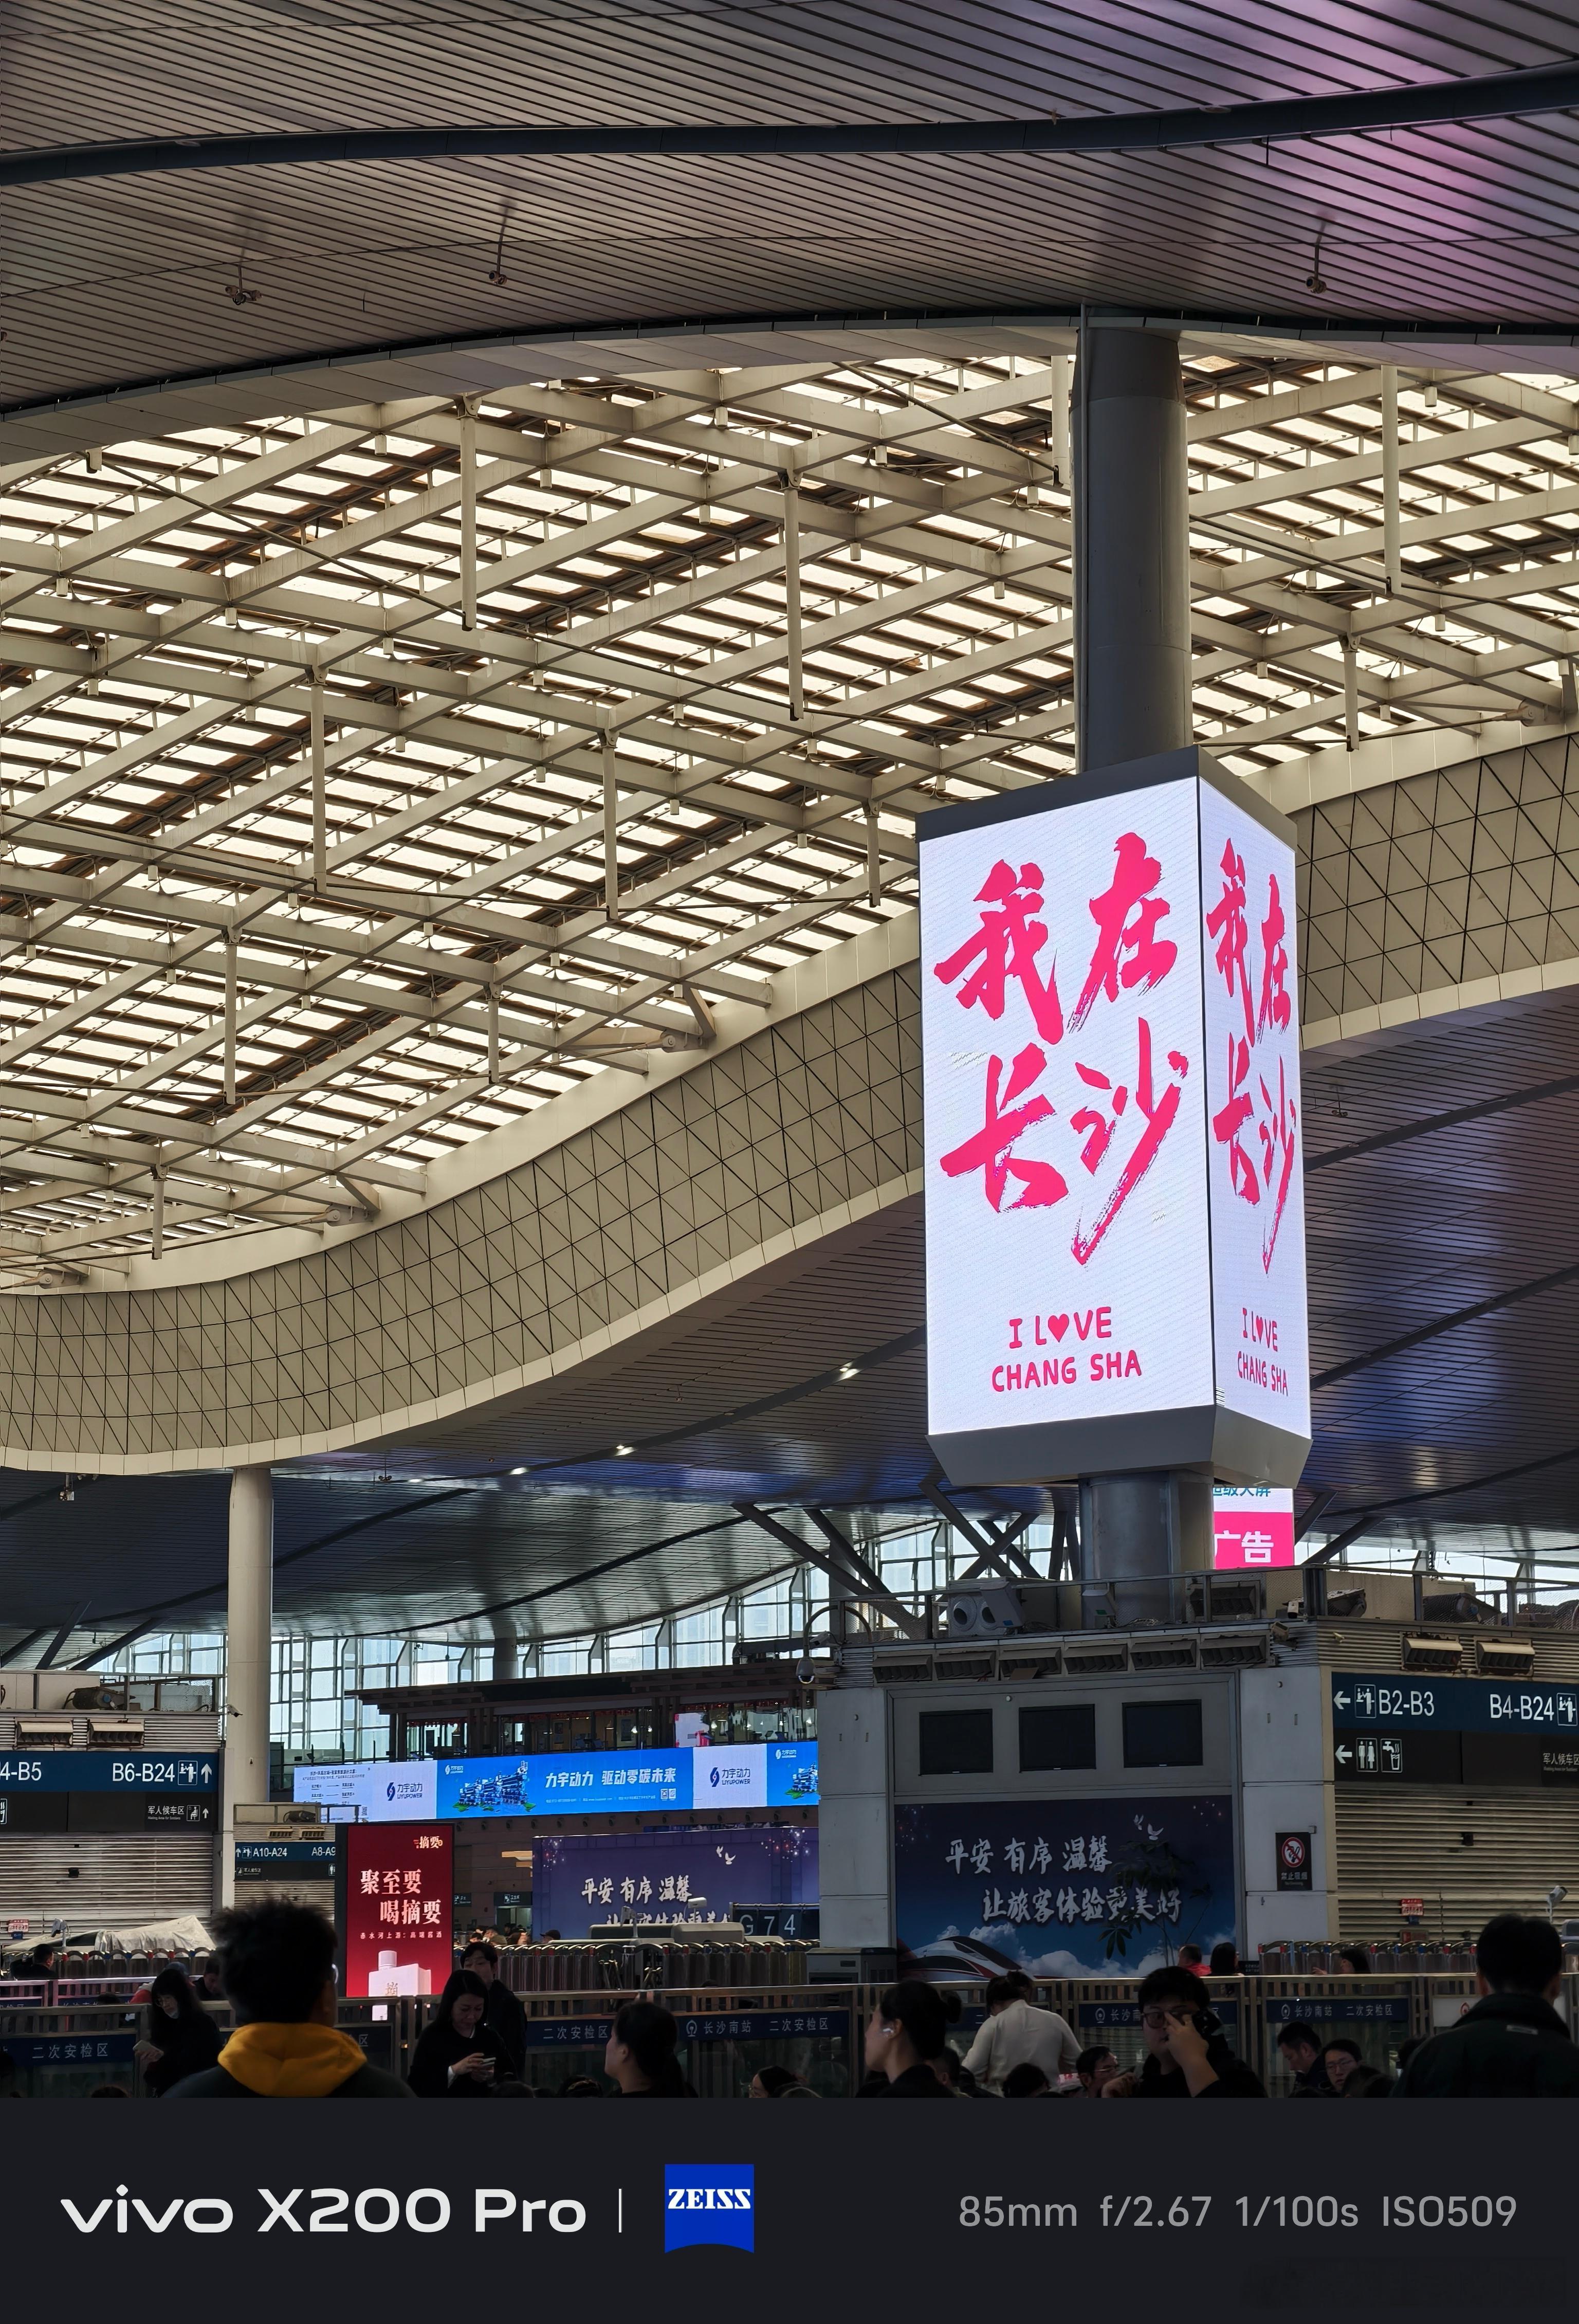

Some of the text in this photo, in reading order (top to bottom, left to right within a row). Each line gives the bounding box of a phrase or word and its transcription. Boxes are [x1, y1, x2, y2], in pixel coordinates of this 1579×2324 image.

[934, 832, 1177, 1044] 我在
[1207, 838, 1290, 1047] 我在
[941, 1017, 1188, 1265] 长沙
[1213, 1033, 1296, 1274] 长沙
[1009, 1318, 1022, 1349] I
[1242, 1308, 1247, 1338] I
[992, 1350, 1142, 1392] CHANG SHA
[1237, 1351, 1288, 1396] CHANG SHA
[1214, 1530, 1274, 1563] 广告
[1379, 1690, 1435, 1716] B2-B3
[1491, 1694, 1554, 1721] B4-B24
[112, 1763, 175, 1782] B6-B24
[148, 1806, 185, 1815] 军人候车区
[253, 1847, 287, 1857] A10-A24
[311, 1847, 336, 1856] A8-A9
[945, 1838, 994, 1874] 平安
[1003, 1837, 1052, 1874] 有序
[360, 1869, 422, 1895] 聚至要
[581, 1878, 614, 1904] 平安
[620, 1876, 652, 1903] 有序
[380, 1899, 441, 1924] 喝摘要
[1294, 2004, 1393, 2017] 长沙南站 二次安检区
[543, 2026, 608, 2040] 二次安检区
[703, 2017, 829, 2034] 长沙南站 二次安检区
[32, 2043, 108, 2059] 二次安检区
